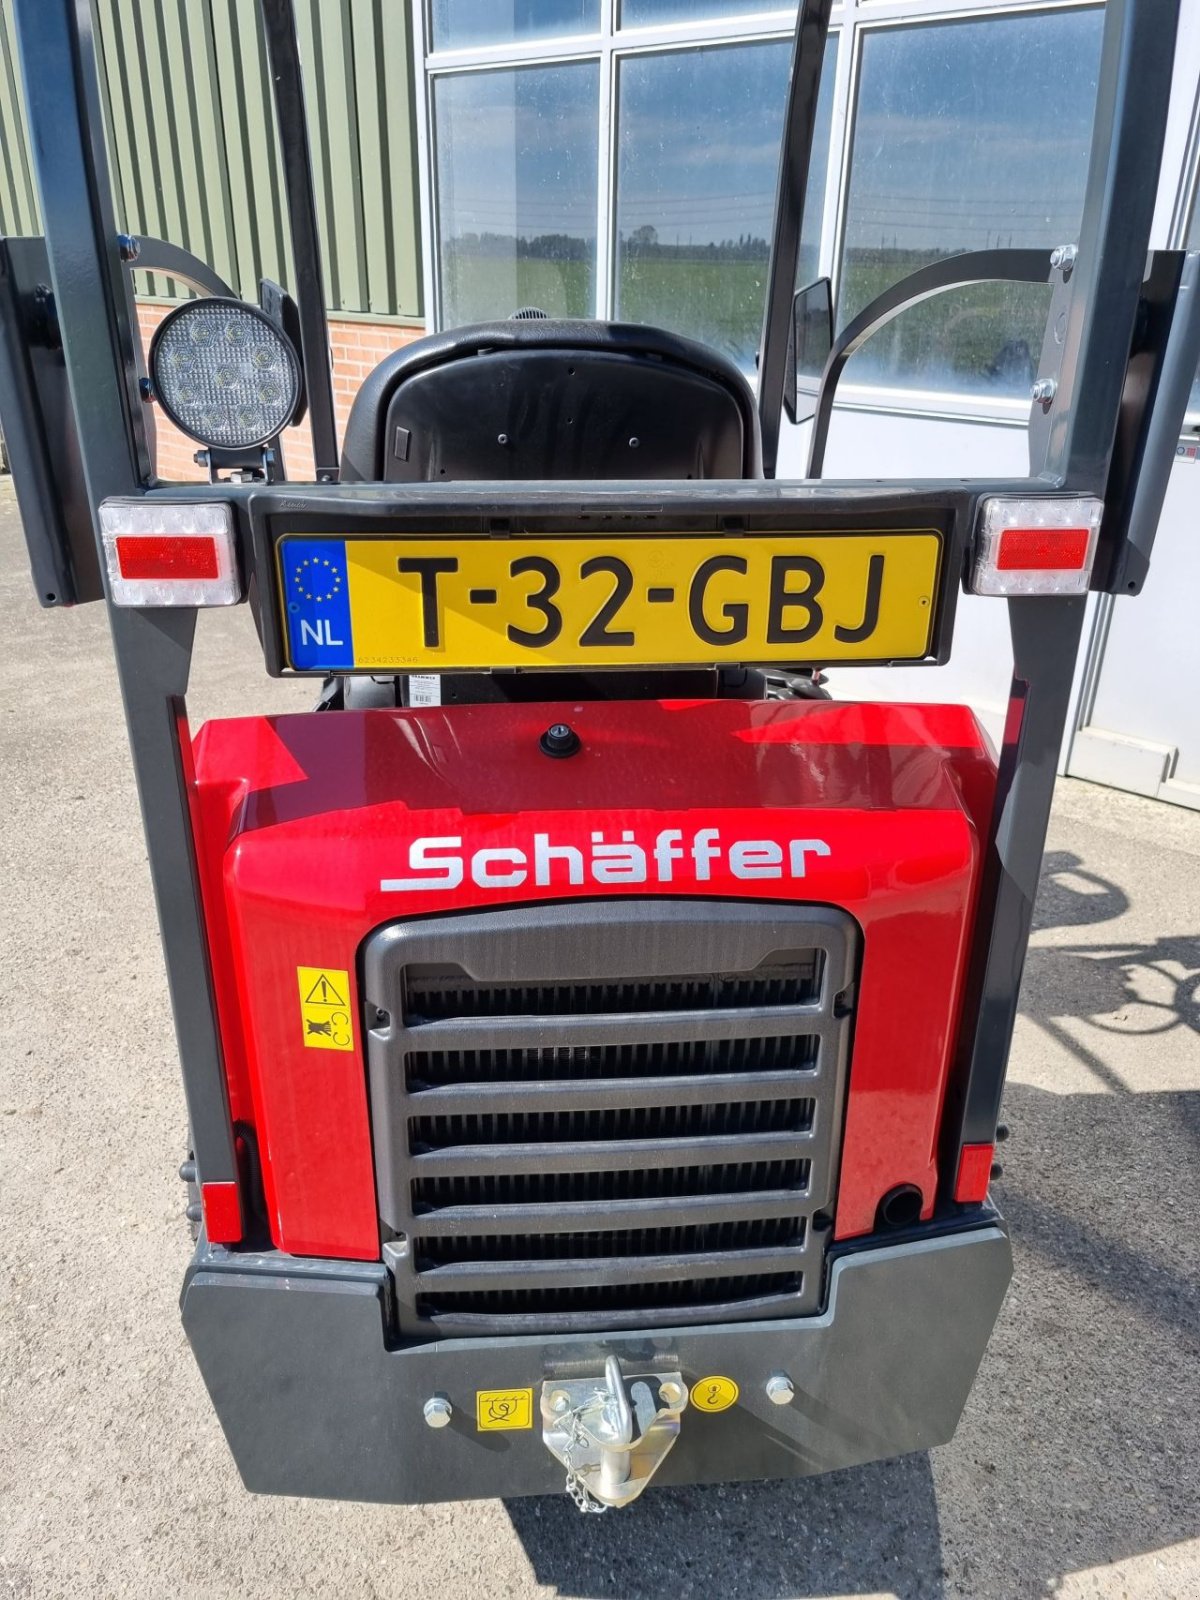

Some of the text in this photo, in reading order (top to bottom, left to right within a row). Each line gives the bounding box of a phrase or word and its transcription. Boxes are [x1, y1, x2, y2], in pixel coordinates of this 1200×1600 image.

[301, 619, 344, 646] NL
[398, 555, 885, 647] T-32-GBJ
[380, 828, 831, 892] Schäffer
